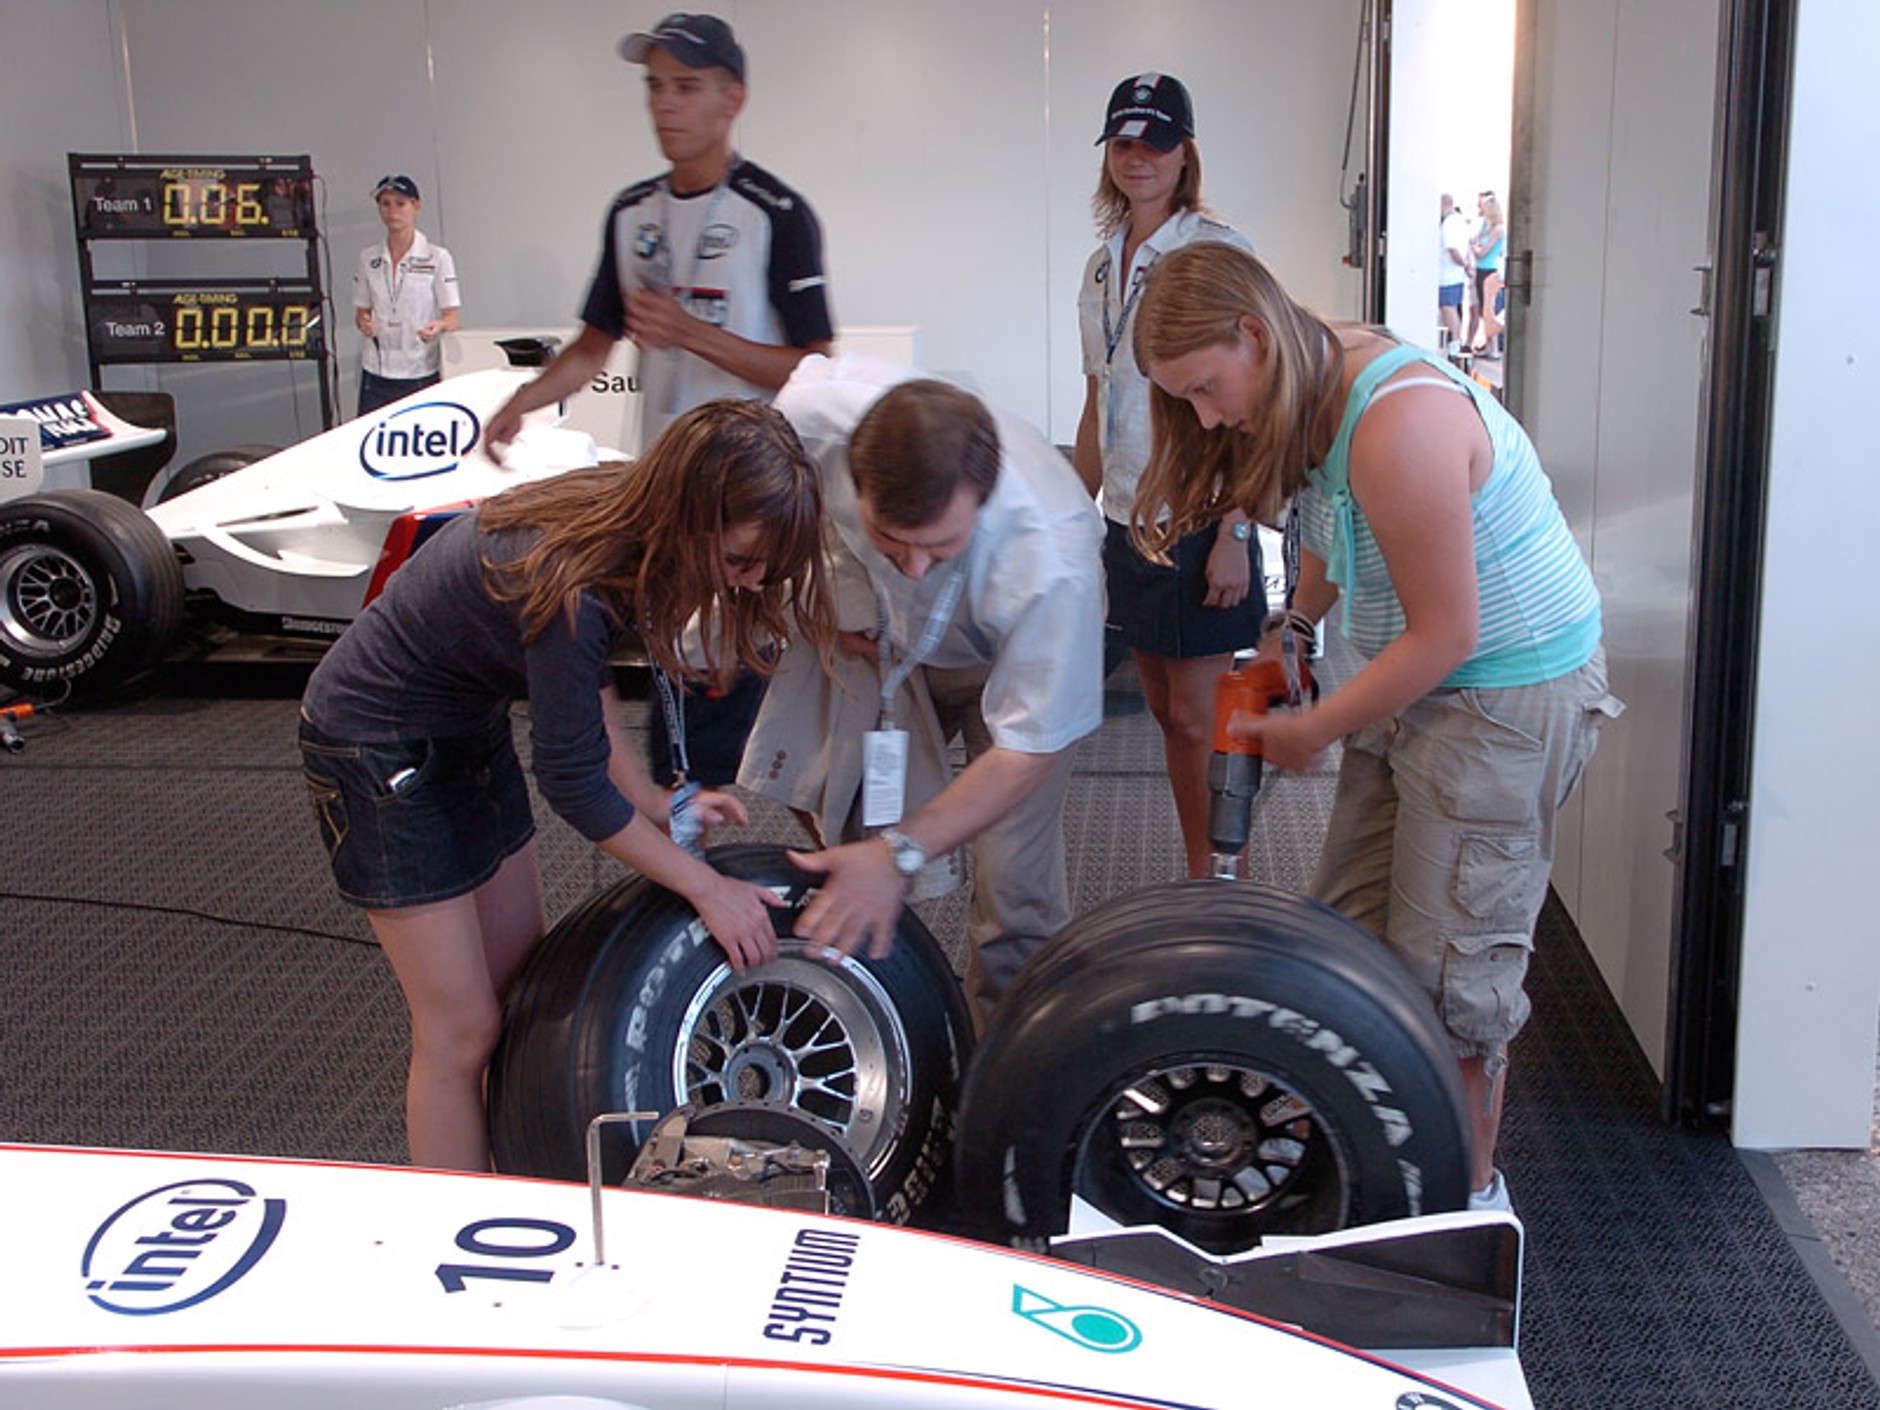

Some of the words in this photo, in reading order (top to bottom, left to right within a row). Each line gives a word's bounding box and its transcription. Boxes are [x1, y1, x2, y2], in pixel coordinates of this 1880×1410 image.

[93, 197, 138, 212] Team
[143, 196, 152, 211] 1
[105, 321, 150, 337] Team
[154, 321, 166, 336] 2
[176, 306, 308, 349] 0.00.0
[376, 421, 459, 457] intel
[85, 1197, 251, 1291] intel
[434, 1217, 577, 1294] 10
[763, 1228, 861, 1346] SYNTIUM
